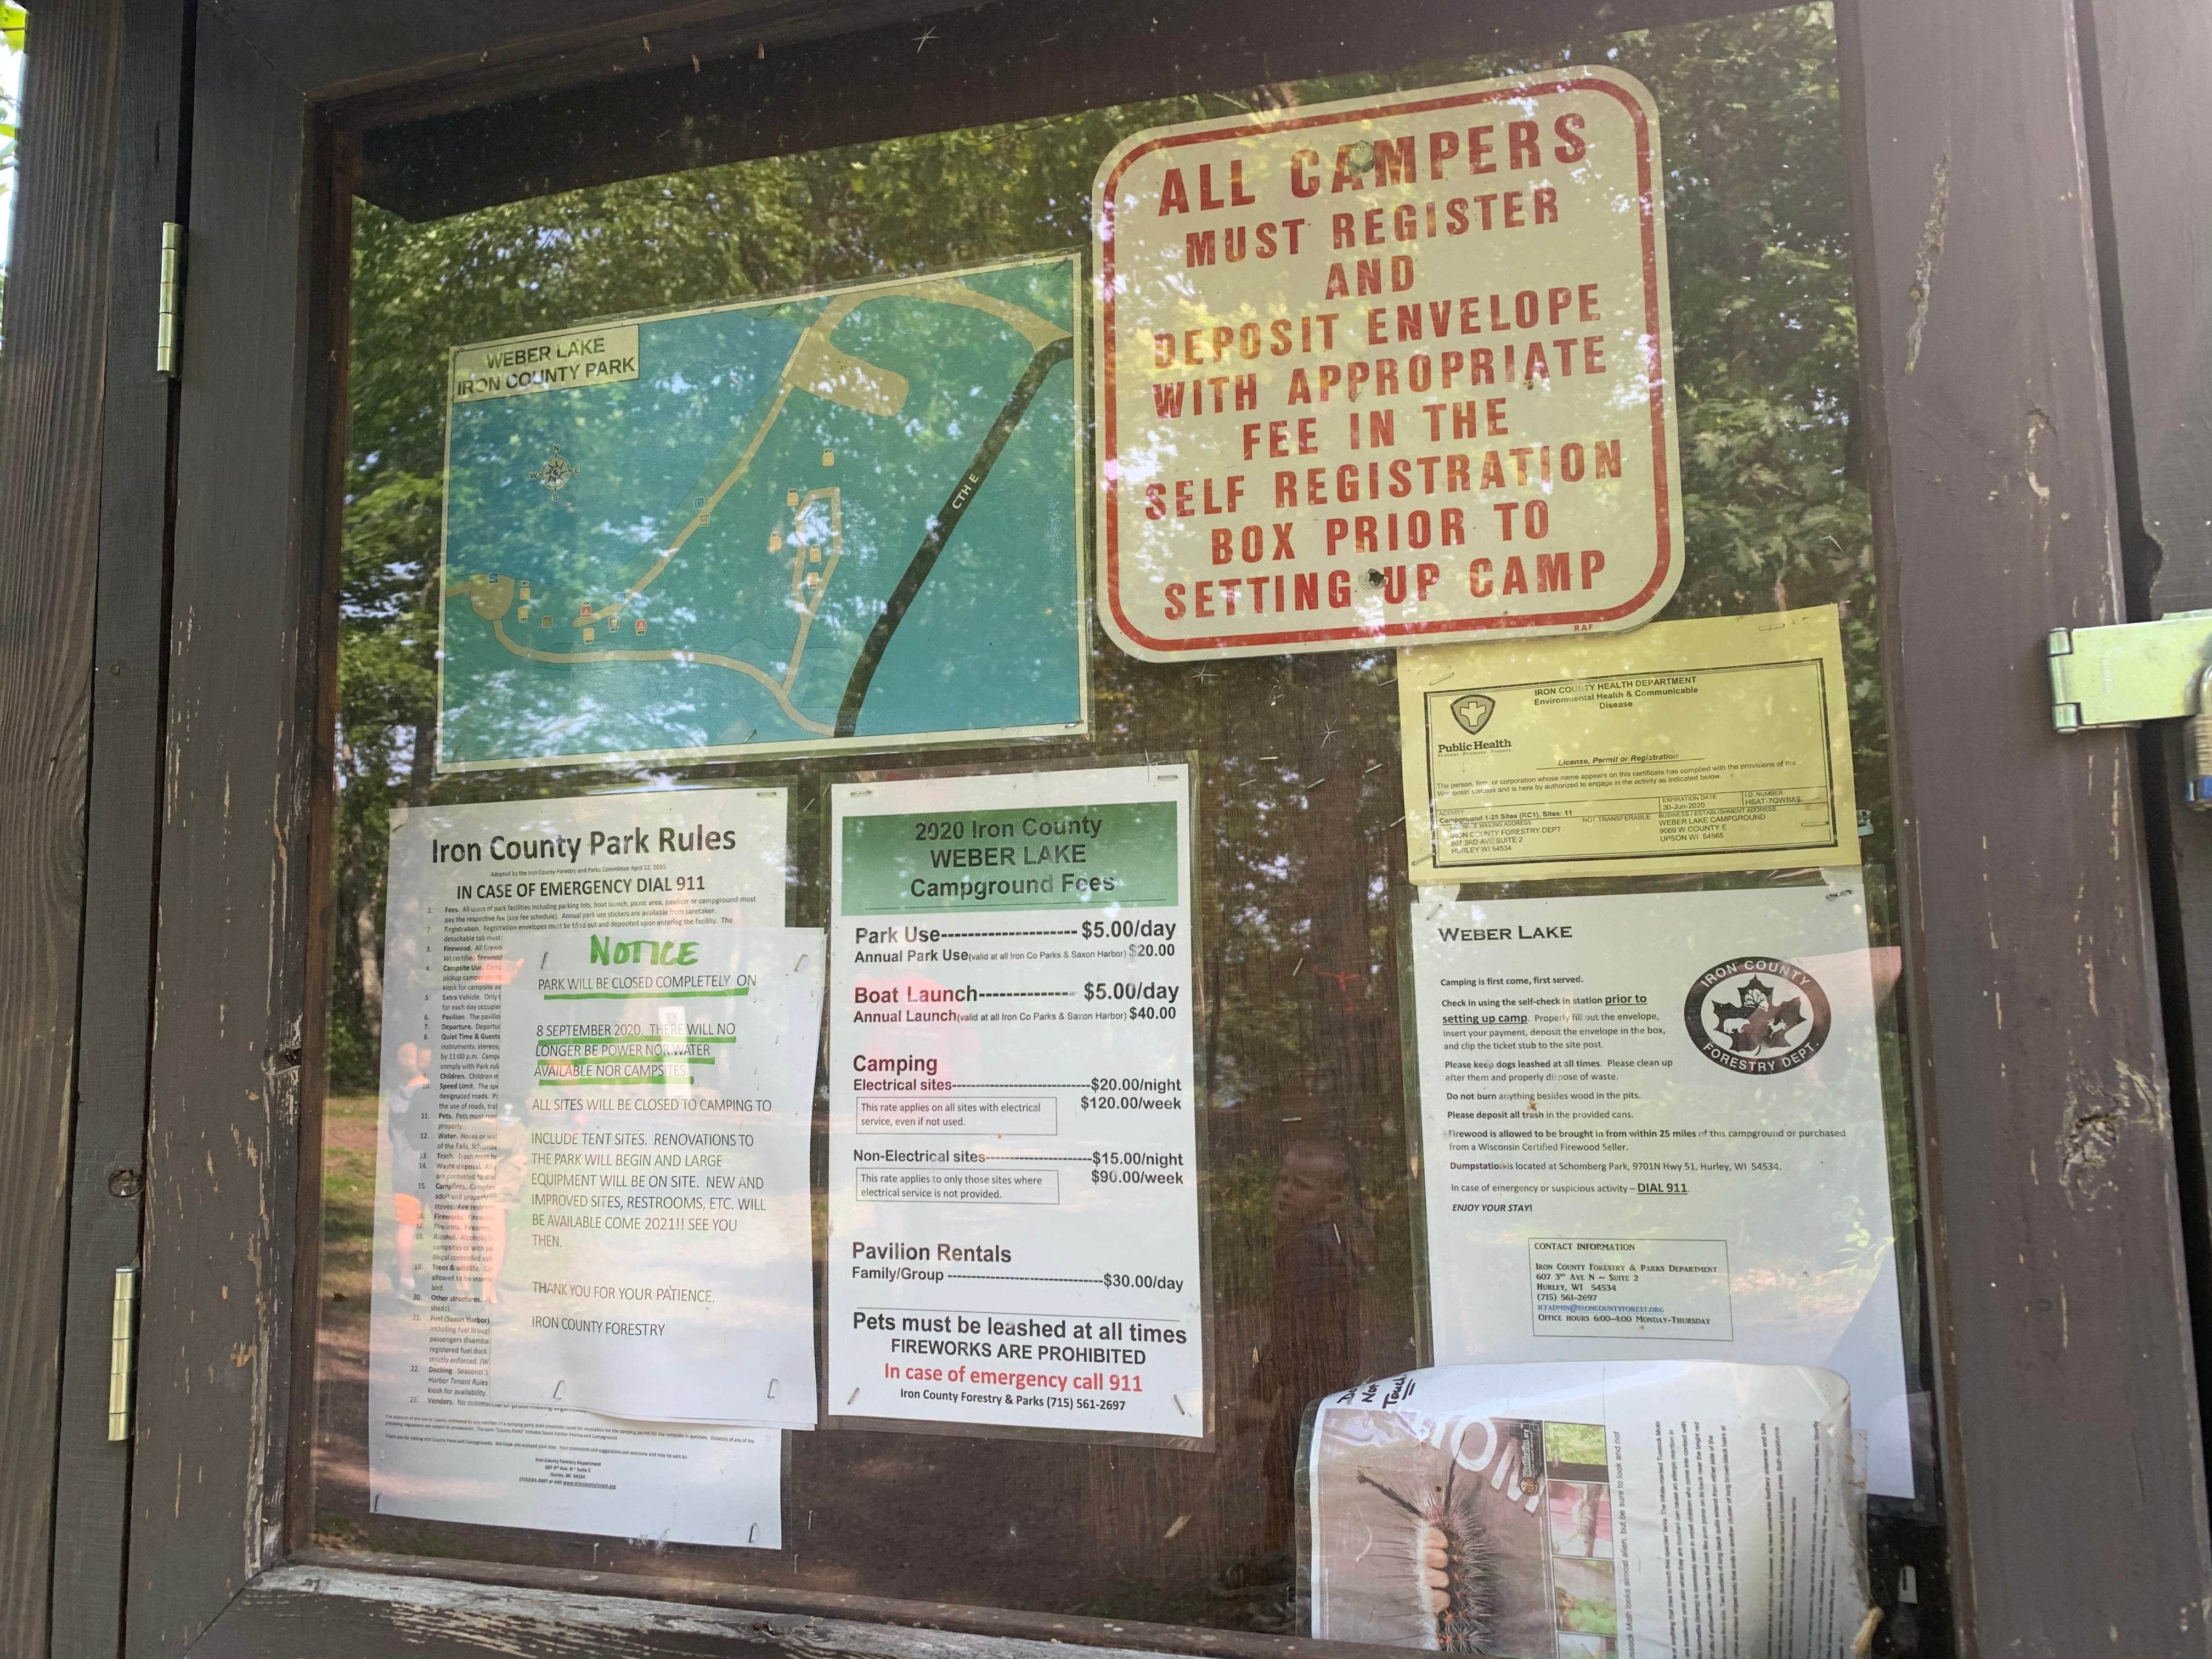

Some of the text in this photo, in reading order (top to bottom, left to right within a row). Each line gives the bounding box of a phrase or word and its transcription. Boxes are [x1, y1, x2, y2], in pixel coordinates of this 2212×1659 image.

[1158, 112, 1587, 216] ALL CAMPERS
[1186, 187, 1558, 268] MUST REGISTER
[1325, 255, 1414, 300] AND
[1153, 283, 1600, 369] DEPOSIT ENVELOPE
[486, 337, 605, 369] WEBER LAKE
[457, 357, 635, 398] IRON COUNTY PARK
[1152, 335, 1606, 419] WITH APPROPRIATE
[1243, 397, 1508, 461] FEE IN THE
[952, 473, 979, 509] CTH E
[1145, 439, 1622, 521] SELF REGISTRATION
[1211, 499, 1549, 565] BOX PRIOR TO
[1165, 550, 1605, 620] SETTING UP CAMP
[1574, 623, 1593, 632] RAF
[1534, 676, 1697, 696] IRON COUNTY HEALTH DEPARTMENT
[1534, 693, 1595, 706] Environmental
[1596, 691, 1623, 700] Health
[1635, 686, 1699, 697] Communicable
[1599, 701, 1633, 709] Disease
[1438, 738, 1512, 753] Public Health
[1663, 802, 1705, 810] 30-Jun-2020
[915, 816, 1102, 841] 2020 Iron County
[1710, 814, 1766, 823] CAMPGROUND
[432, 824, 736, 864] Iron County Park Rules
[930, 844, 1086, 868] WEBER LAKE
[457, 876, 705, 900] IN CASE OF EMERGENCY DIAL 911
[911, 873, 1116, 900] Campground Fees
[856, 927, 898, 944] Park
[1082, 919, 1176, 941] $5.00/day
[1437, 926, 1573, 941] WEBER LAKE
[538, 974, 757, 990] PARK WILL BE CLOSED COMPLETELY ON
[1441, 978, 1477, 987] Camping
[1553, 975, 1584, 984] served.
[1700, 960, 1810, 988] IRON COUNTY
[537, 1023, 736, 1036] 8 SEPTEMBER 2020. THERE WILL NO
[535, 1044, 710, 1057] LONGER BE POWER NOR WATER
[1703, 1042, 1775, 1072] FORESTRY
[534, 1065, 592, 1077] AVAILABLE
[596, 1065, 621, 1076] NOR
[853, 1054, 937, 1076] Camping
[1081, 1095, 1181, 1111] $120.00/week
[1092, 1169, 1183, 1185] $90.00/week
[853, 1242, 1012, 1263] Pavilion Rentals
[1537, 1293, 1557, 1301] (715)
[854, 1312, 1187, 1344] Pets must be leashed at all times
[891, 1339, 1146, 1364] FIREWORKS ARE PROHIBITED
[885, 1363, 1143, 1392] In case of emergency call 911
[901, 1388, 1126, 1410] Iron County Forestry & Parks (715) 561-2697
